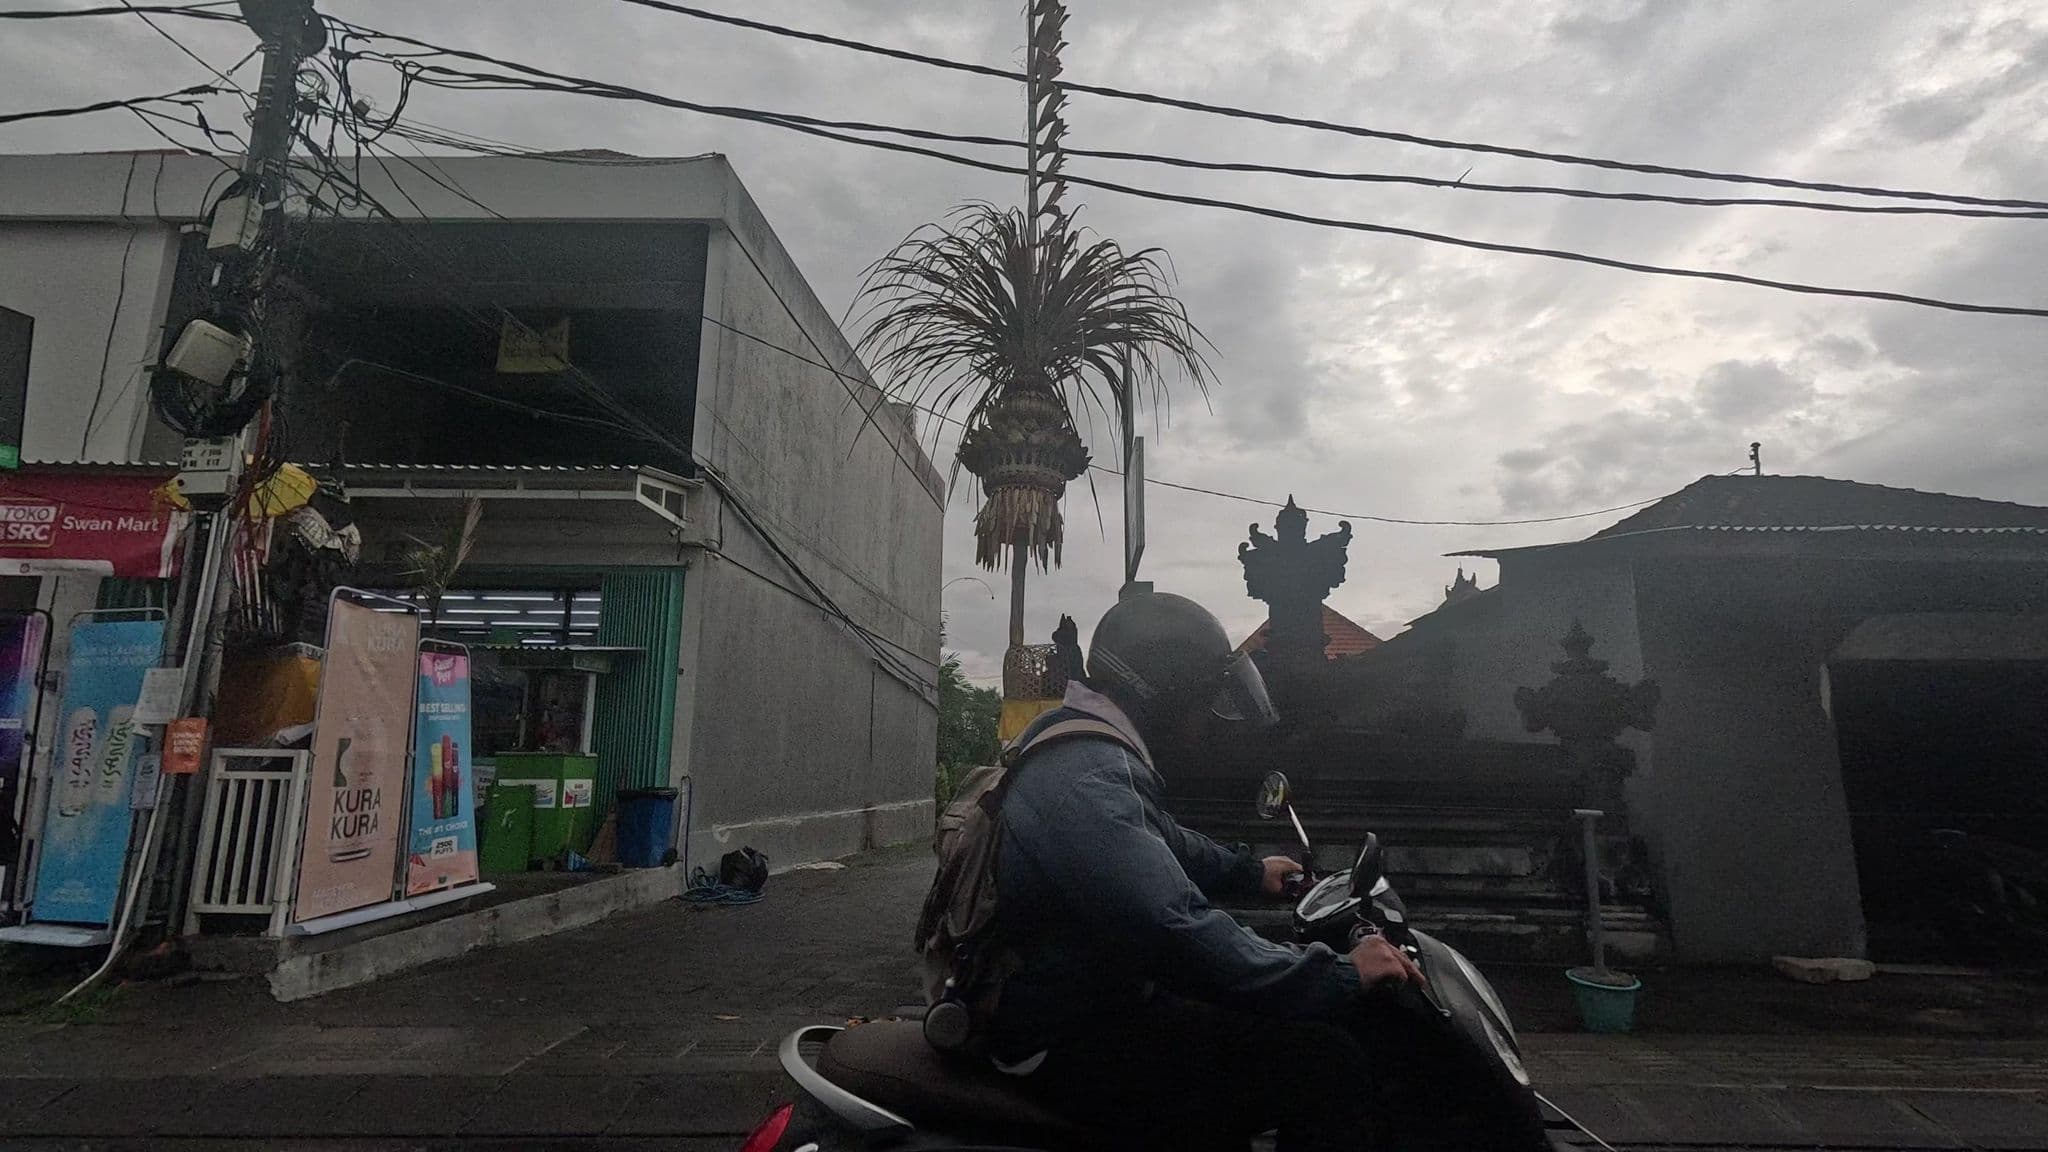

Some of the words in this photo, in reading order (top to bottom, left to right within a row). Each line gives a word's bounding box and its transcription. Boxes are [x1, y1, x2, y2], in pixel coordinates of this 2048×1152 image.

[4, 506, 50, 521] TOKO
[6, 523, 49, 541] SRC
[61, 515, 112, 531] Swan
[116, 516, 160, 532] Mart
[333, 787, 381, 814] KURA
[330, 812, 378, 840] KURA
